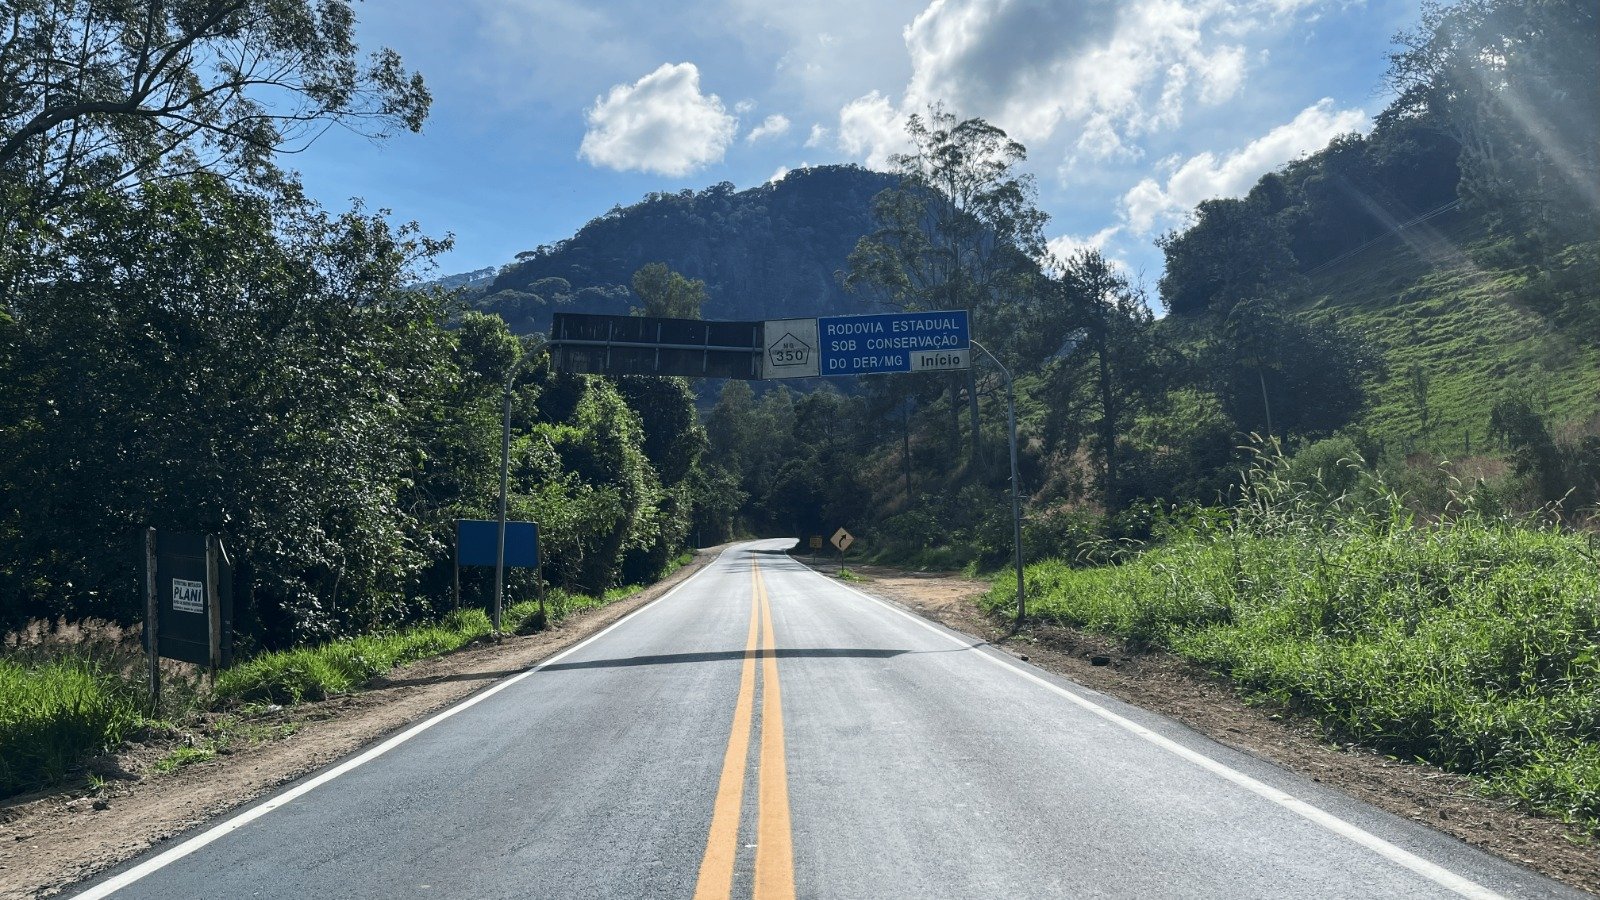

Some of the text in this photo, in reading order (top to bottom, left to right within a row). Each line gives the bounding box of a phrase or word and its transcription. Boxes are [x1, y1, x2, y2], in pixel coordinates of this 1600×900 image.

[827, 318, 960, 336] RODOVIA ESTADUAL
[831, 332, 958, 352] SOB CONSERVAÇÃO
[776, 350, 803, 362] 350
[829, 355, 903, 370] DO DER/MG
[921, 353, 960, 367] Início
[174, 587, 202, 602] PLANI
